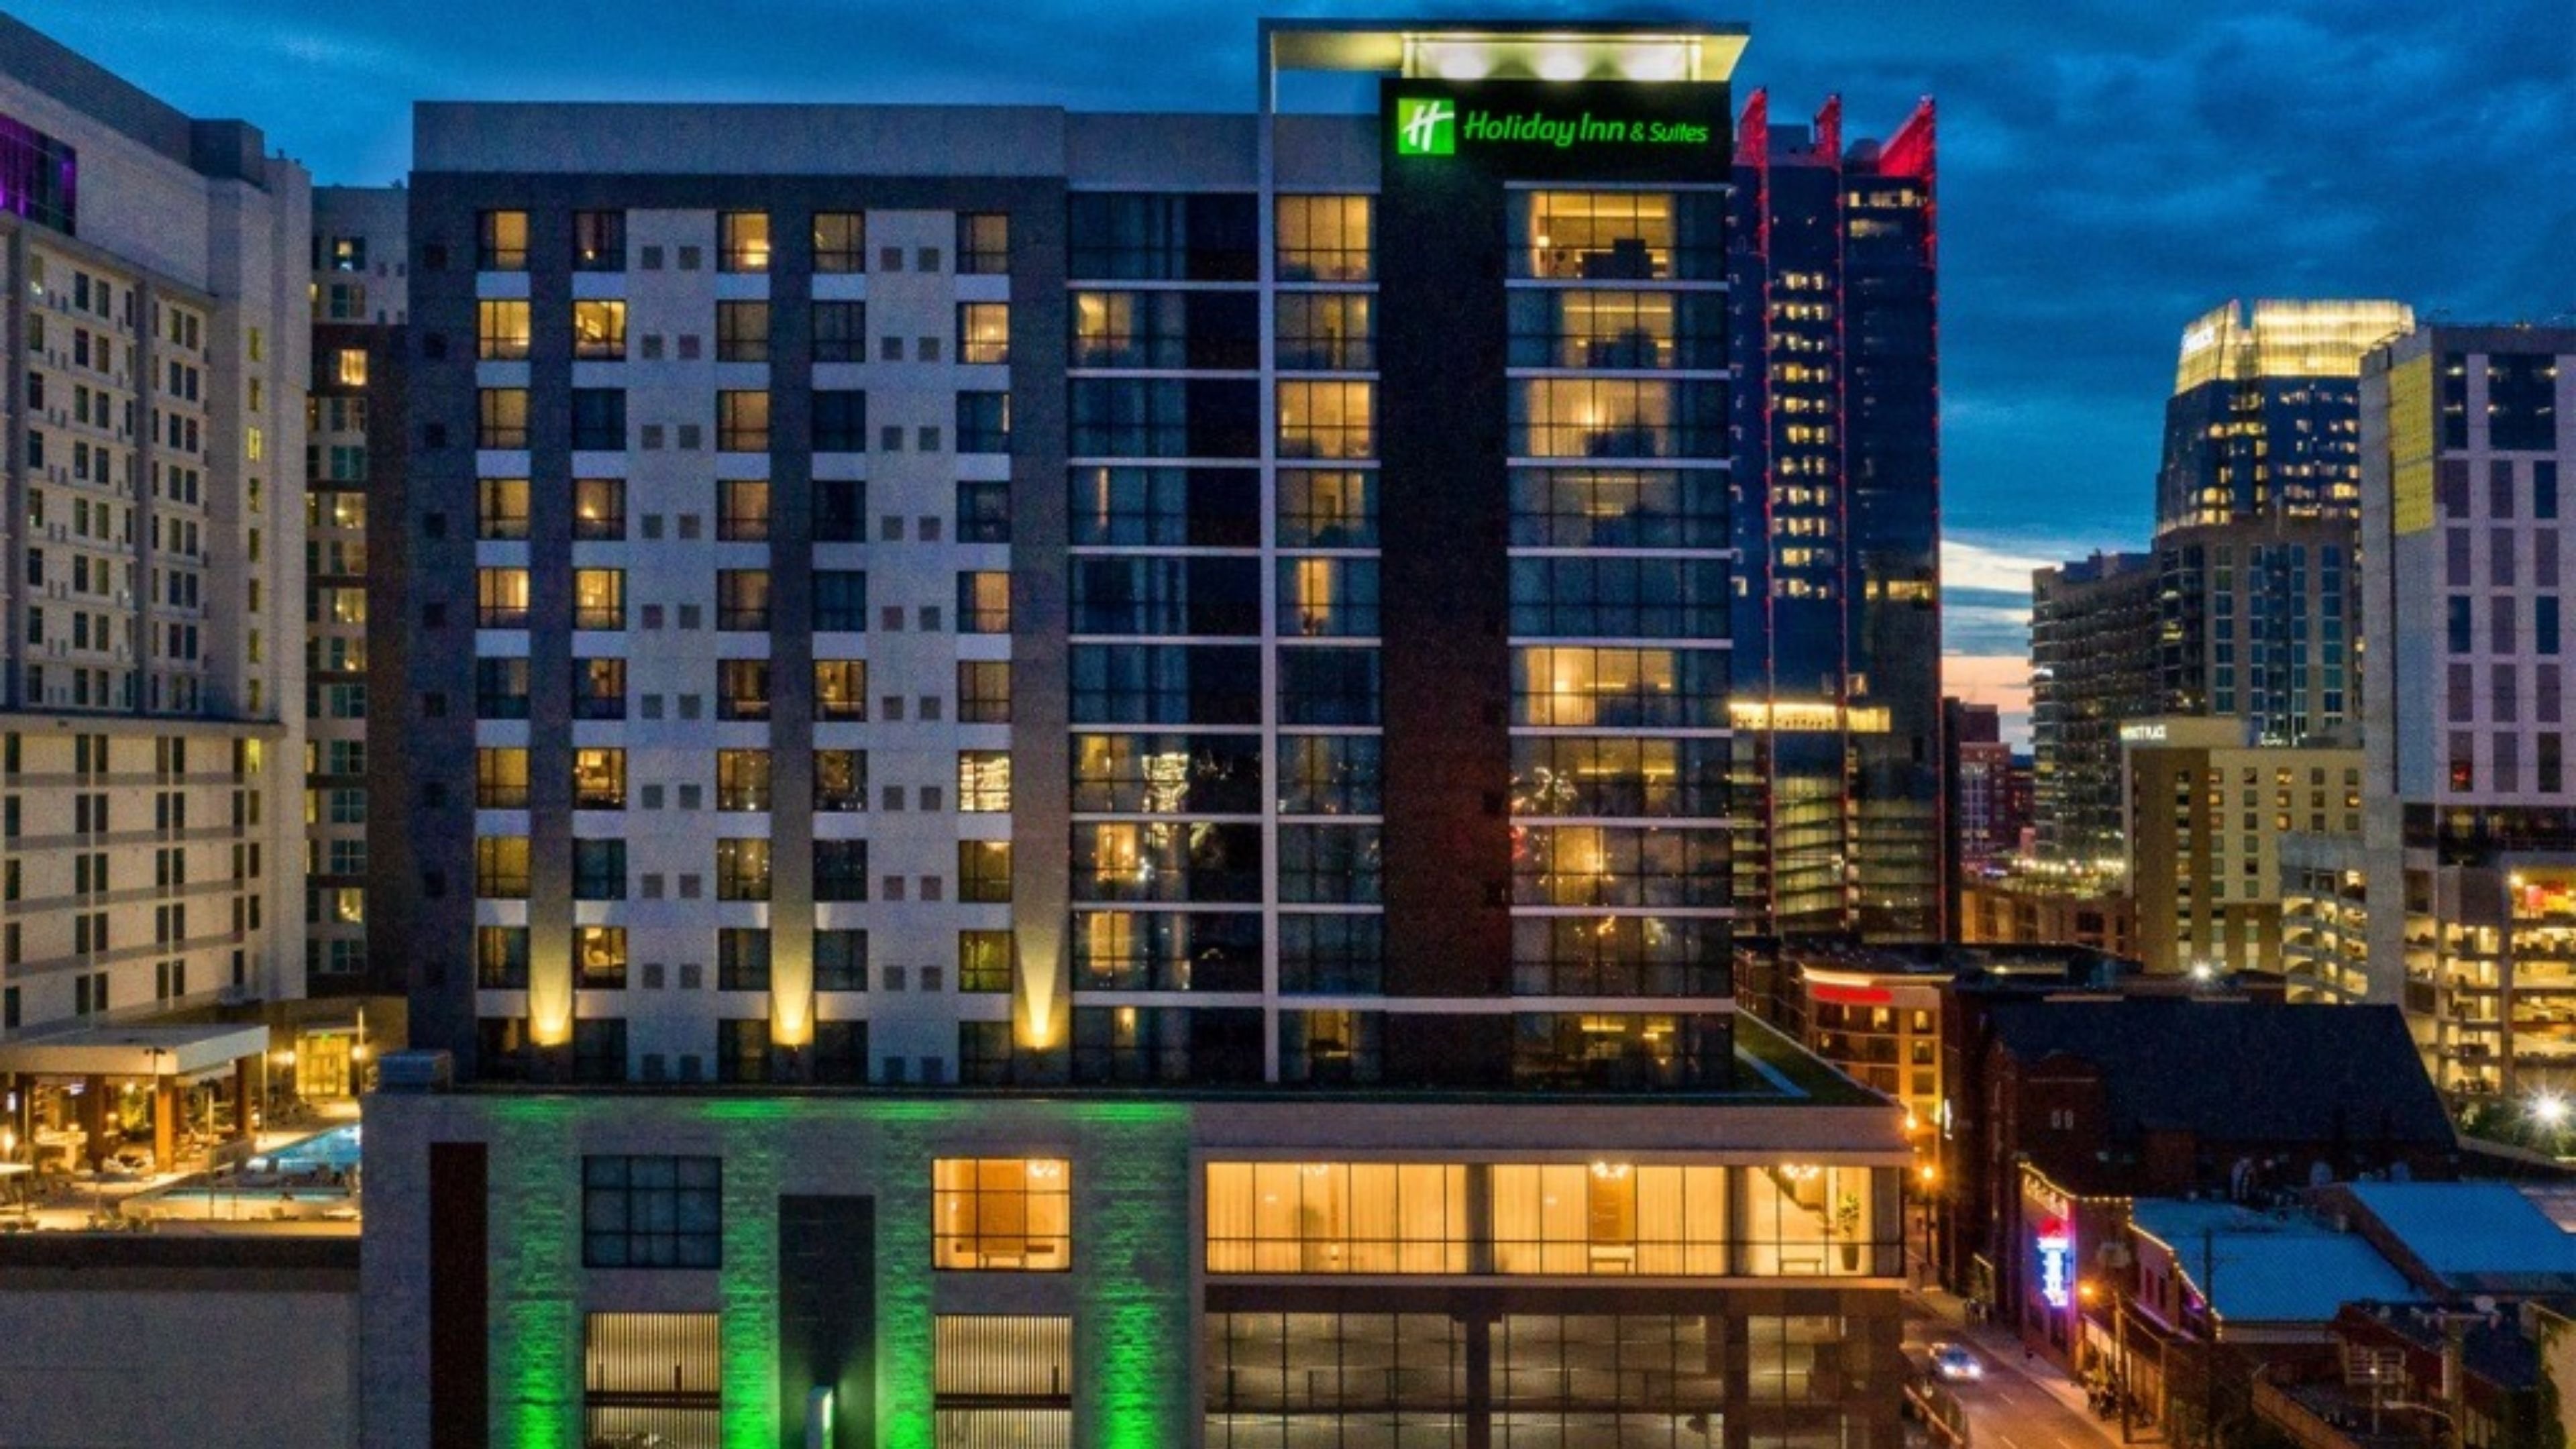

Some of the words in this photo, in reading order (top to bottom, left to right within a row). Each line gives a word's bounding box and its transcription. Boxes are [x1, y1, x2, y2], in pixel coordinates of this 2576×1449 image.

[1463, 111, 1576, 147] Holiday
[1579, 112, 1626, 142] Inn
[1629, 122, 1645, 142] &
[1648, 122, 1709, 142] Suites
